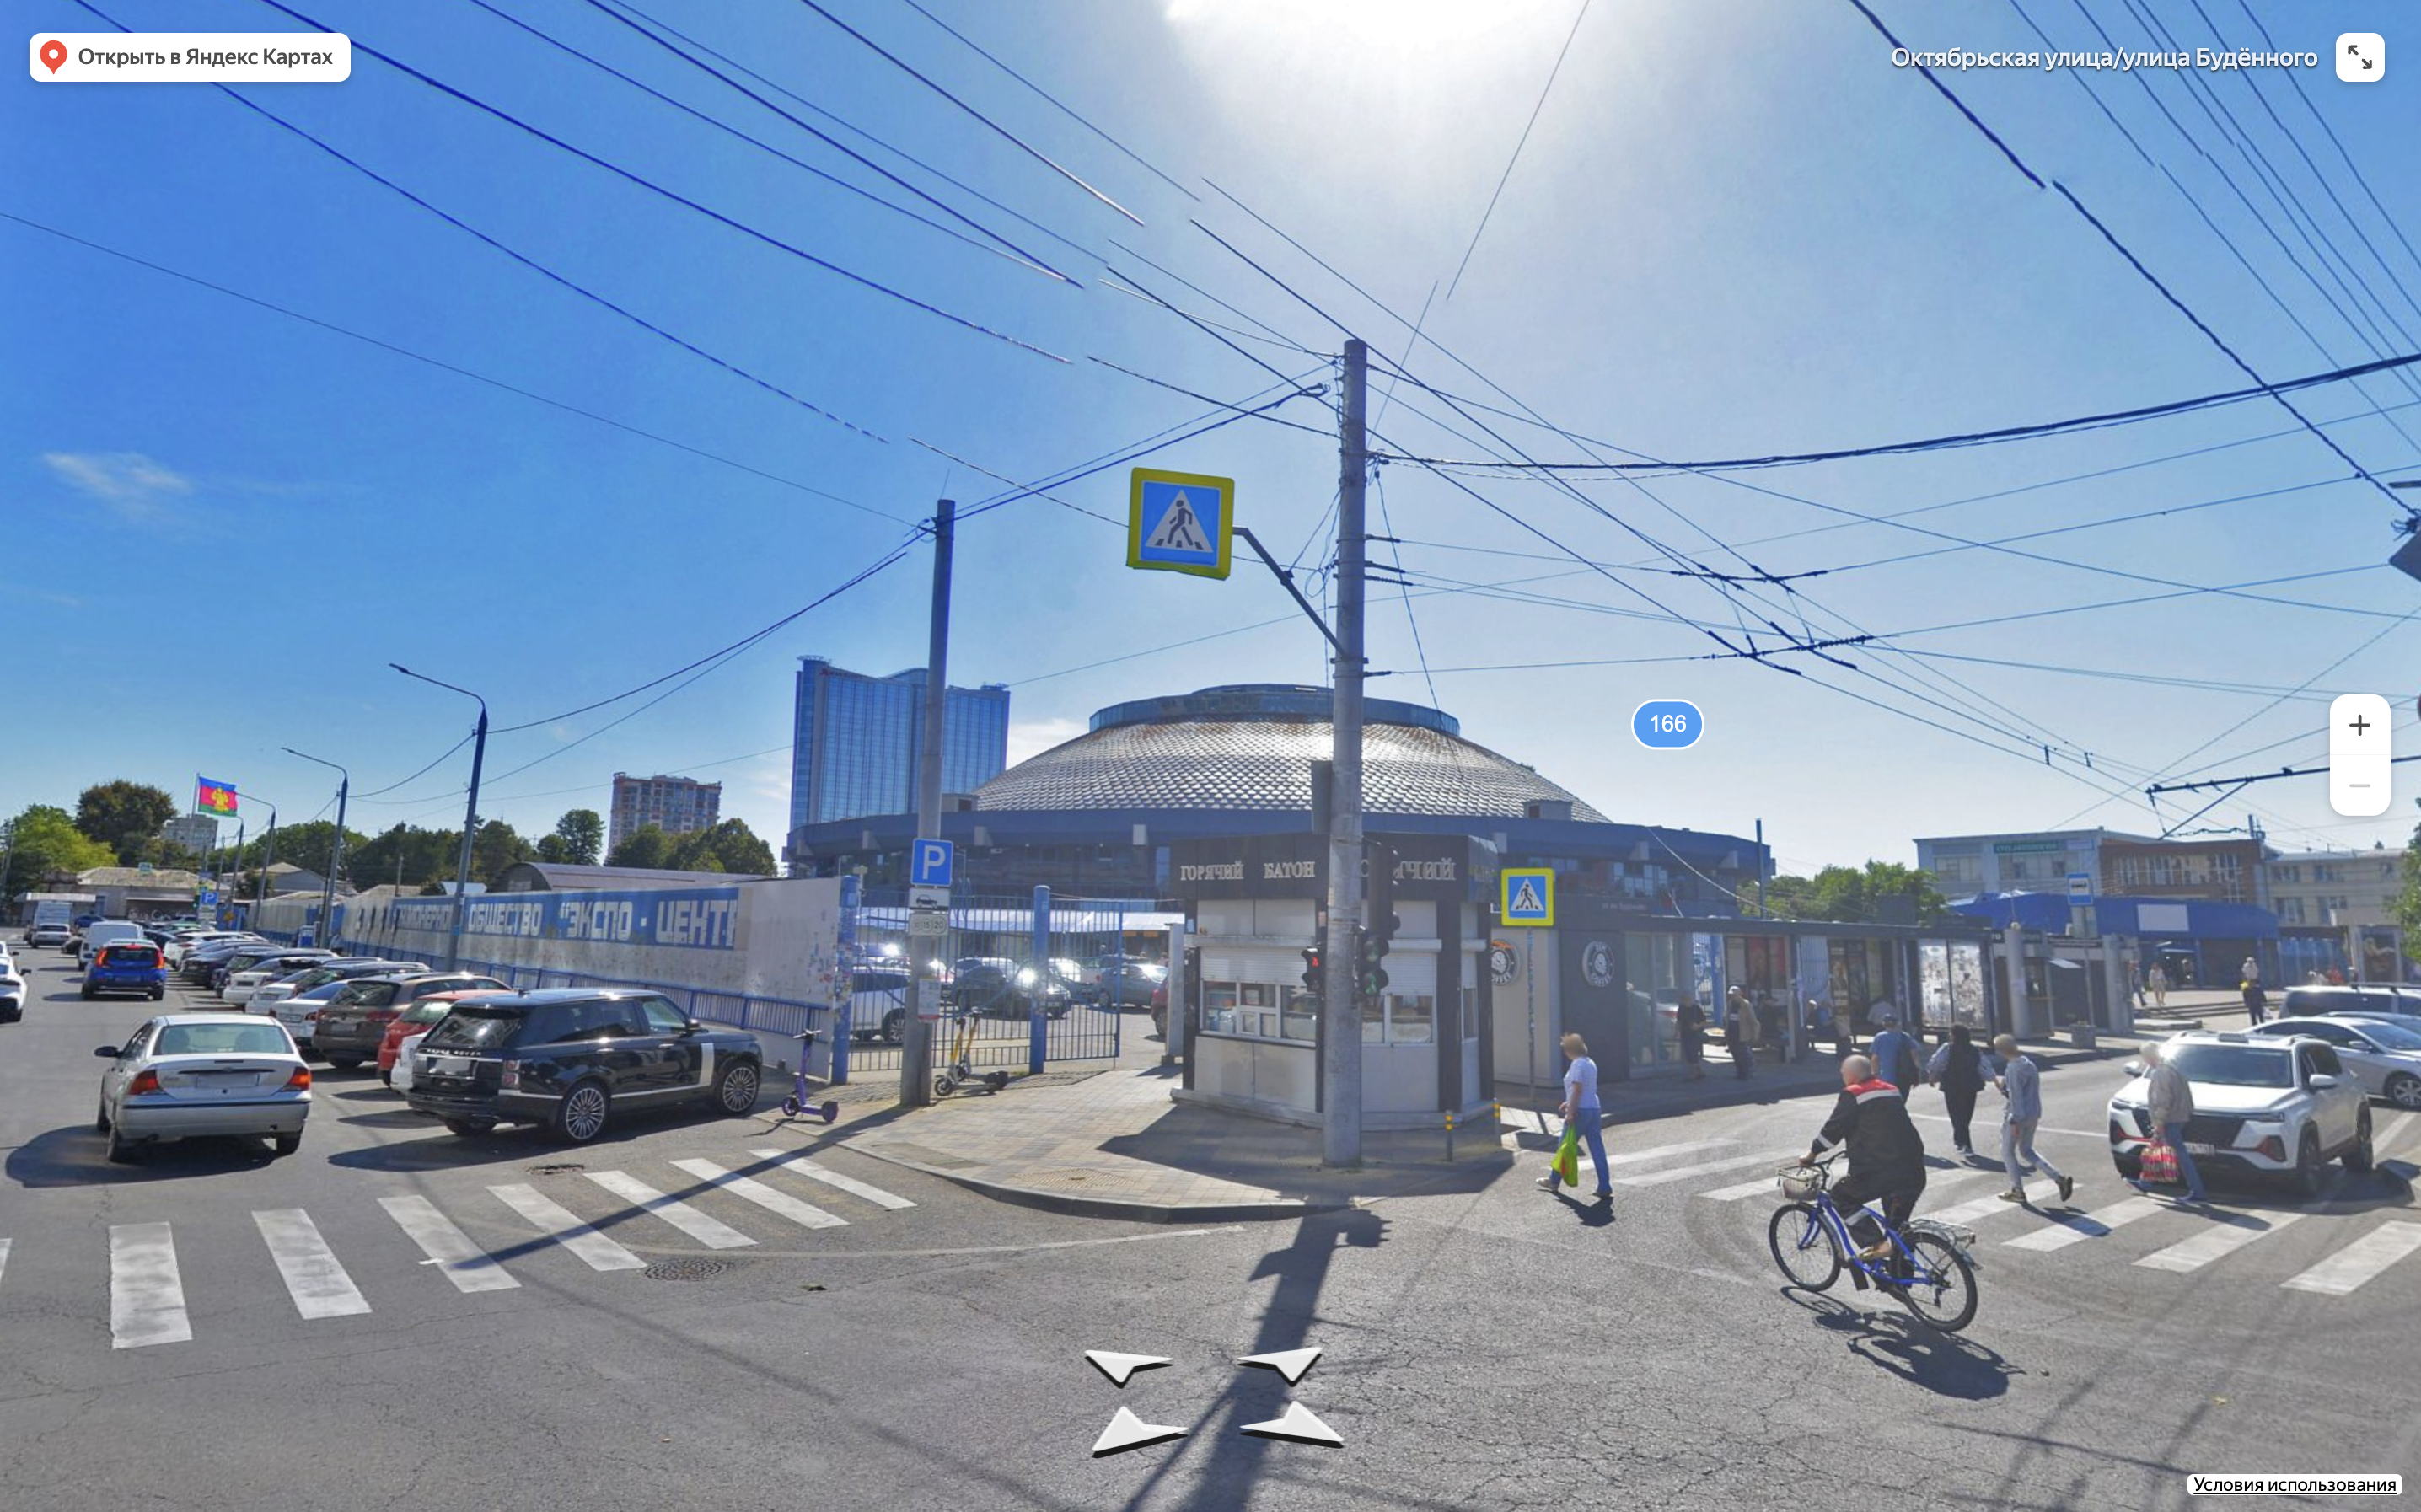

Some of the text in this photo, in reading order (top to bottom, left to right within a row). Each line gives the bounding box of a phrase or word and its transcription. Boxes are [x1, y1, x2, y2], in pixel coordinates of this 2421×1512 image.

[922, 844, 946, 880] P
[1180, 861, 1316, 880] ГОРЯЧИЙ БАТОН
[467, 902, 544, 936] ОБЩЕСТВО
[934, 920, 944, 930] 20
